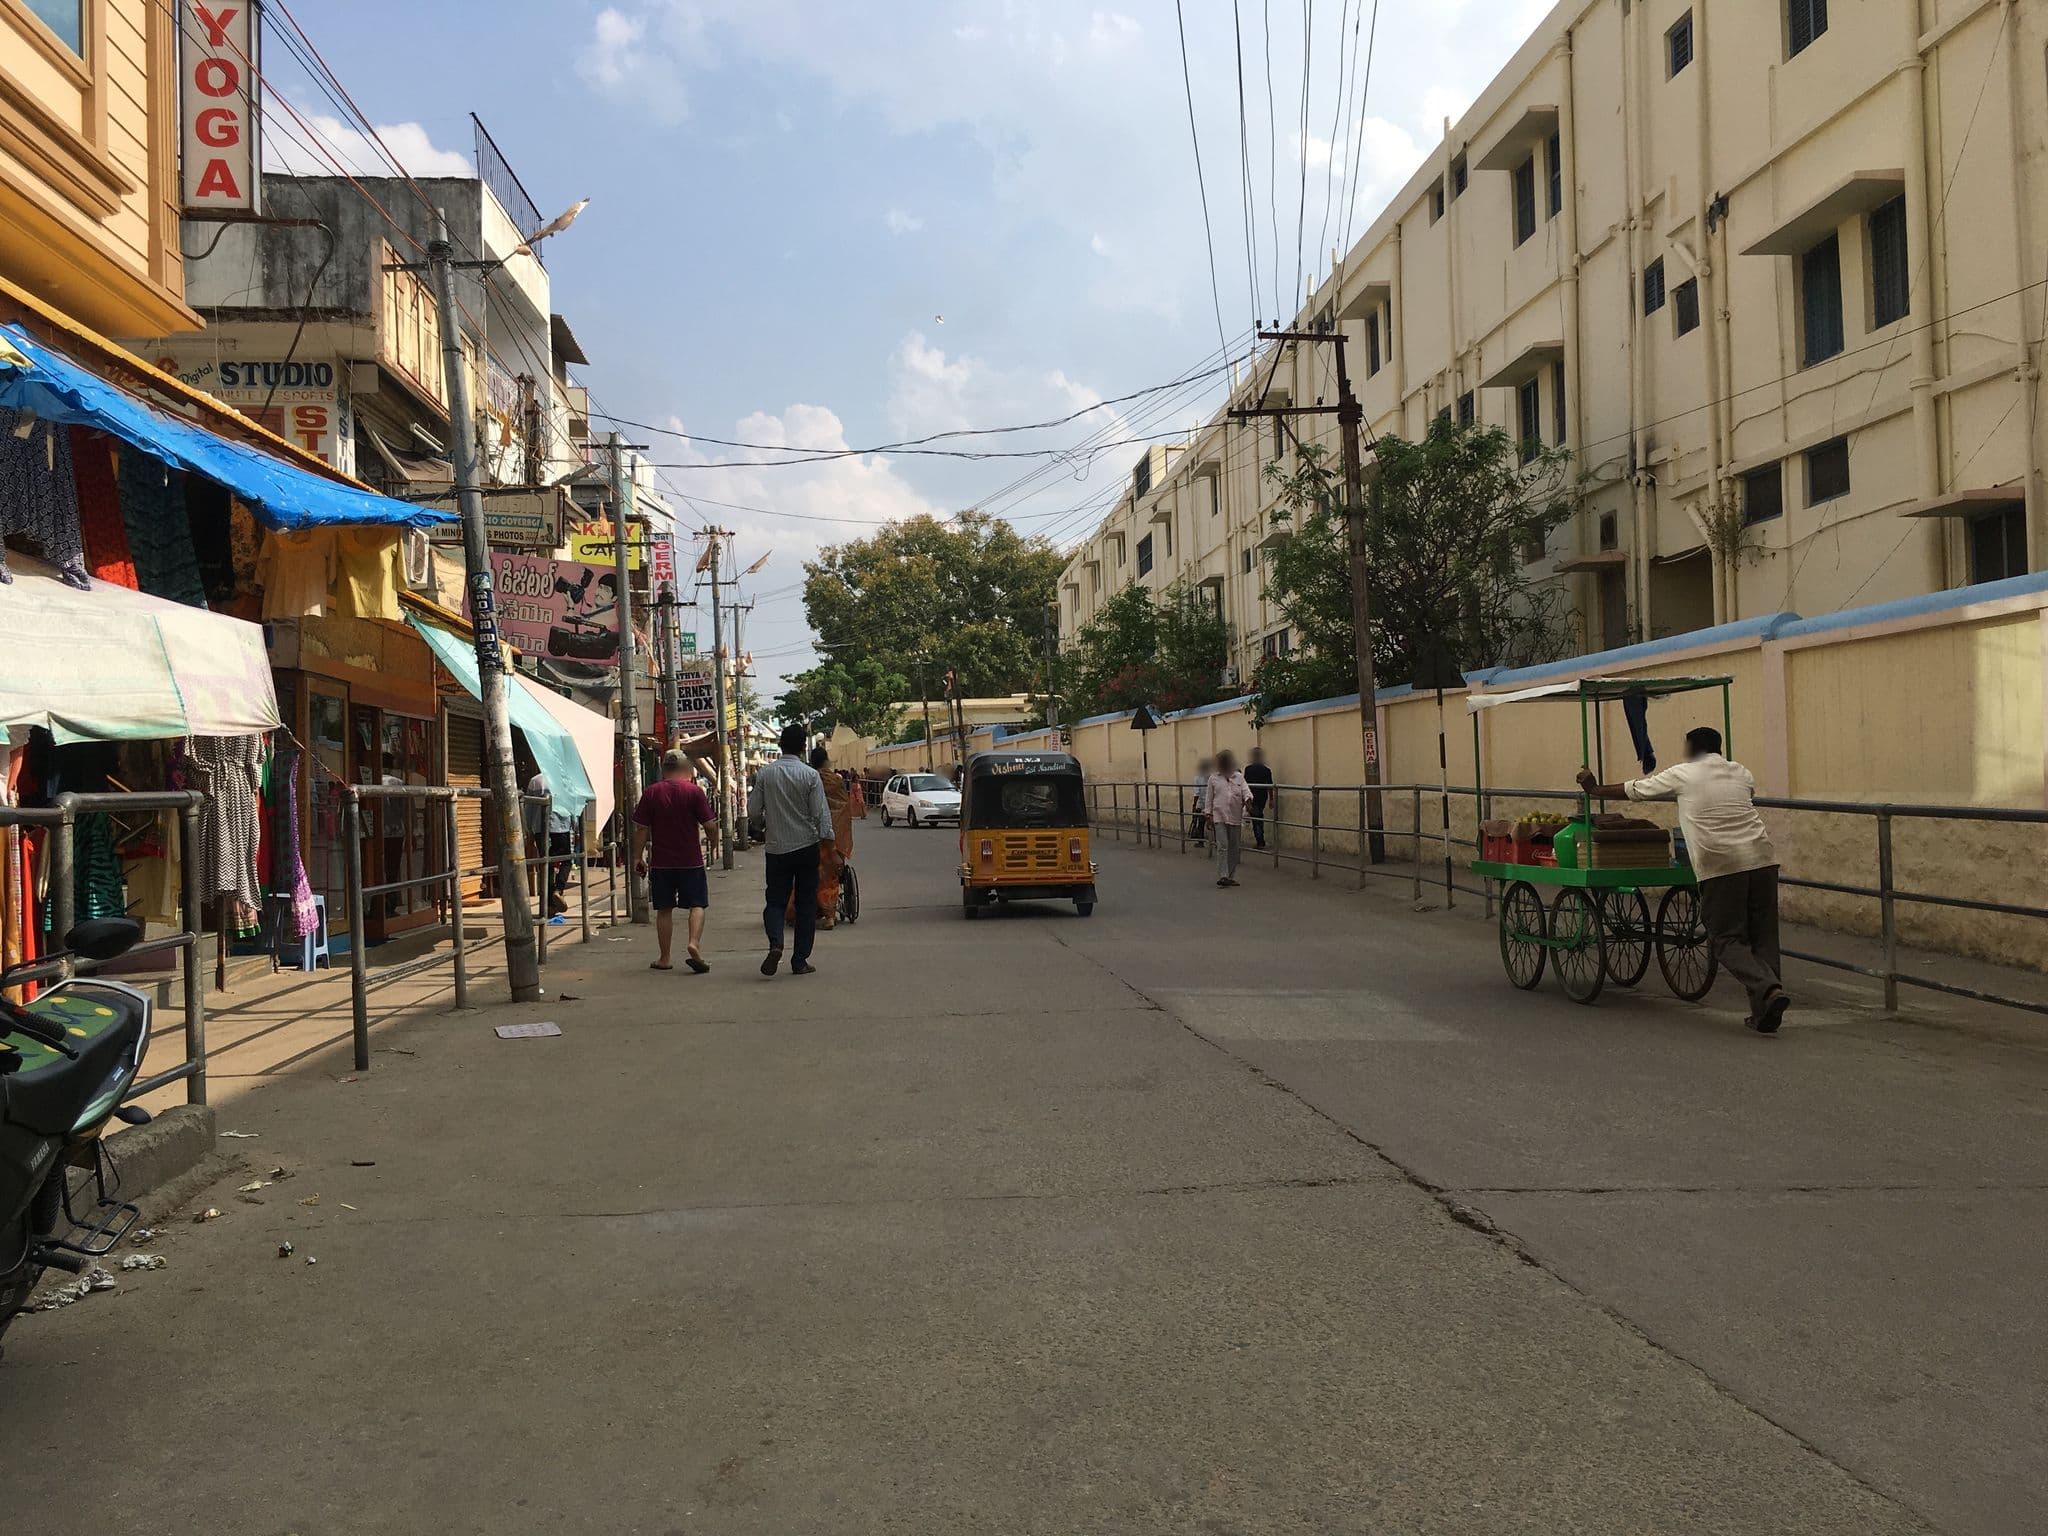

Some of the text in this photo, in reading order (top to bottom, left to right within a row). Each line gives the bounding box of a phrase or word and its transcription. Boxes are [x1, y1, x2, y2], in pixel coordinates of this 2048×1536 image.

[194, 8, 241, 198] YOGA
[180, 368, 214, 389] Digital
[219, 361, 334, 388] STUDIO
[494, 531, 525, 540] PHOTOS
